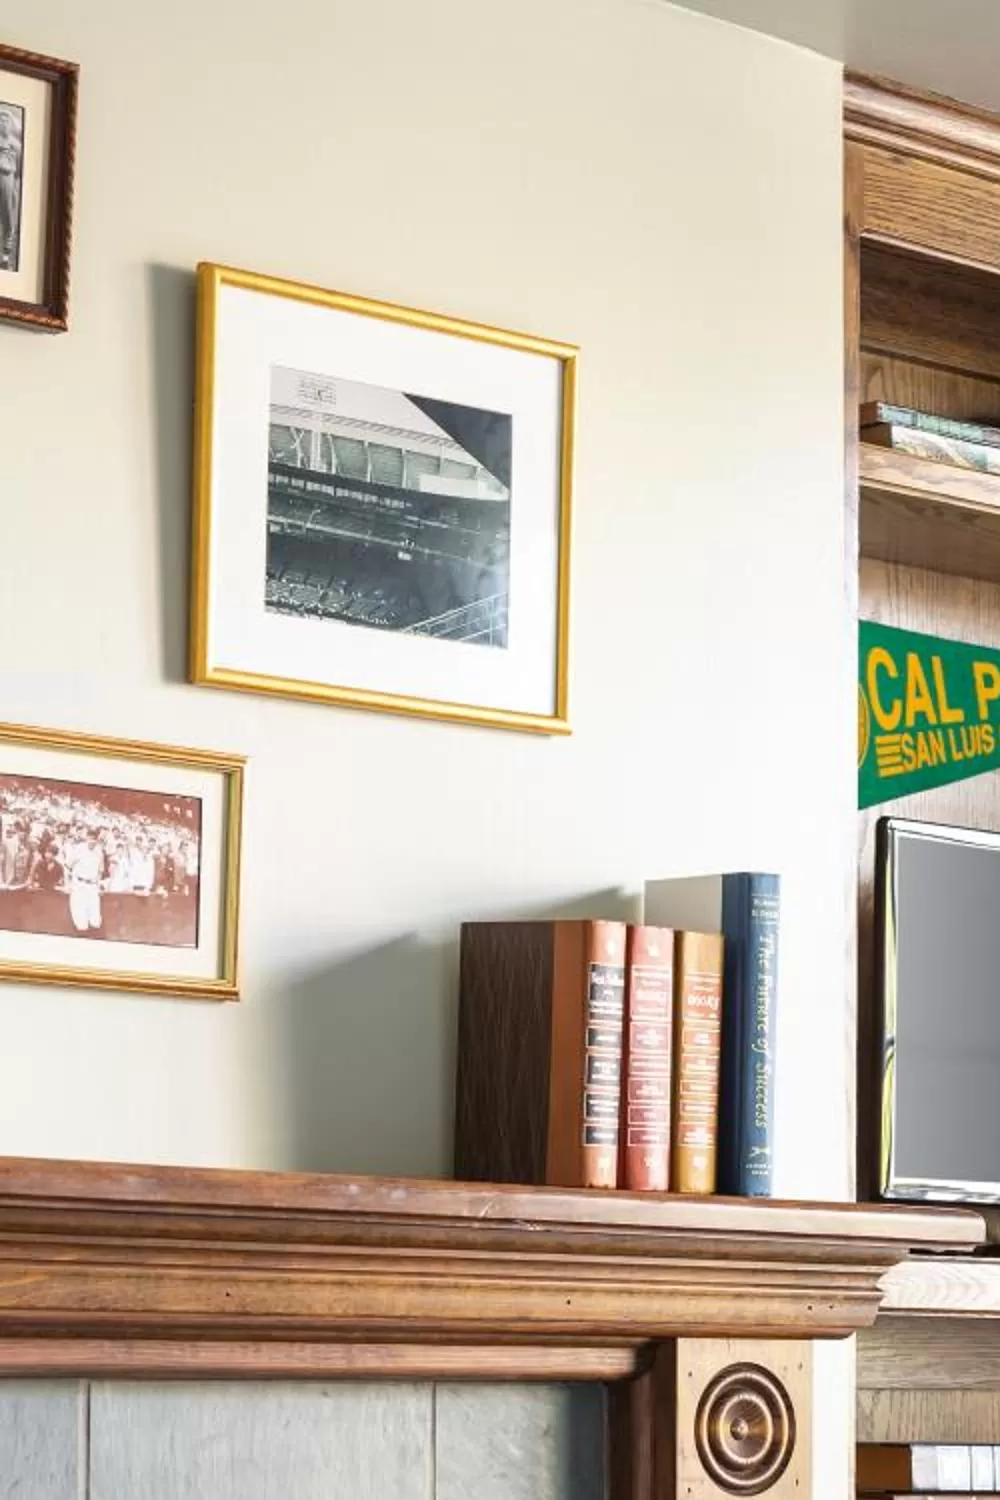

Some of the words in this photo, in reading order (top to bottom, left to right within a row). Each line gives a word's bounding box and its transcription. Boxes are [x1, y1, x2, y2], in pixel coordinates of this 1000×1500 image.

[867, 646, 964, 731] CAL
[899, 732, 947, 773] SAN
[949, 723, 995, 761] LUIS
[756, 974, 773, 1032] Future
[755, 1062, 772, 1129] Success
